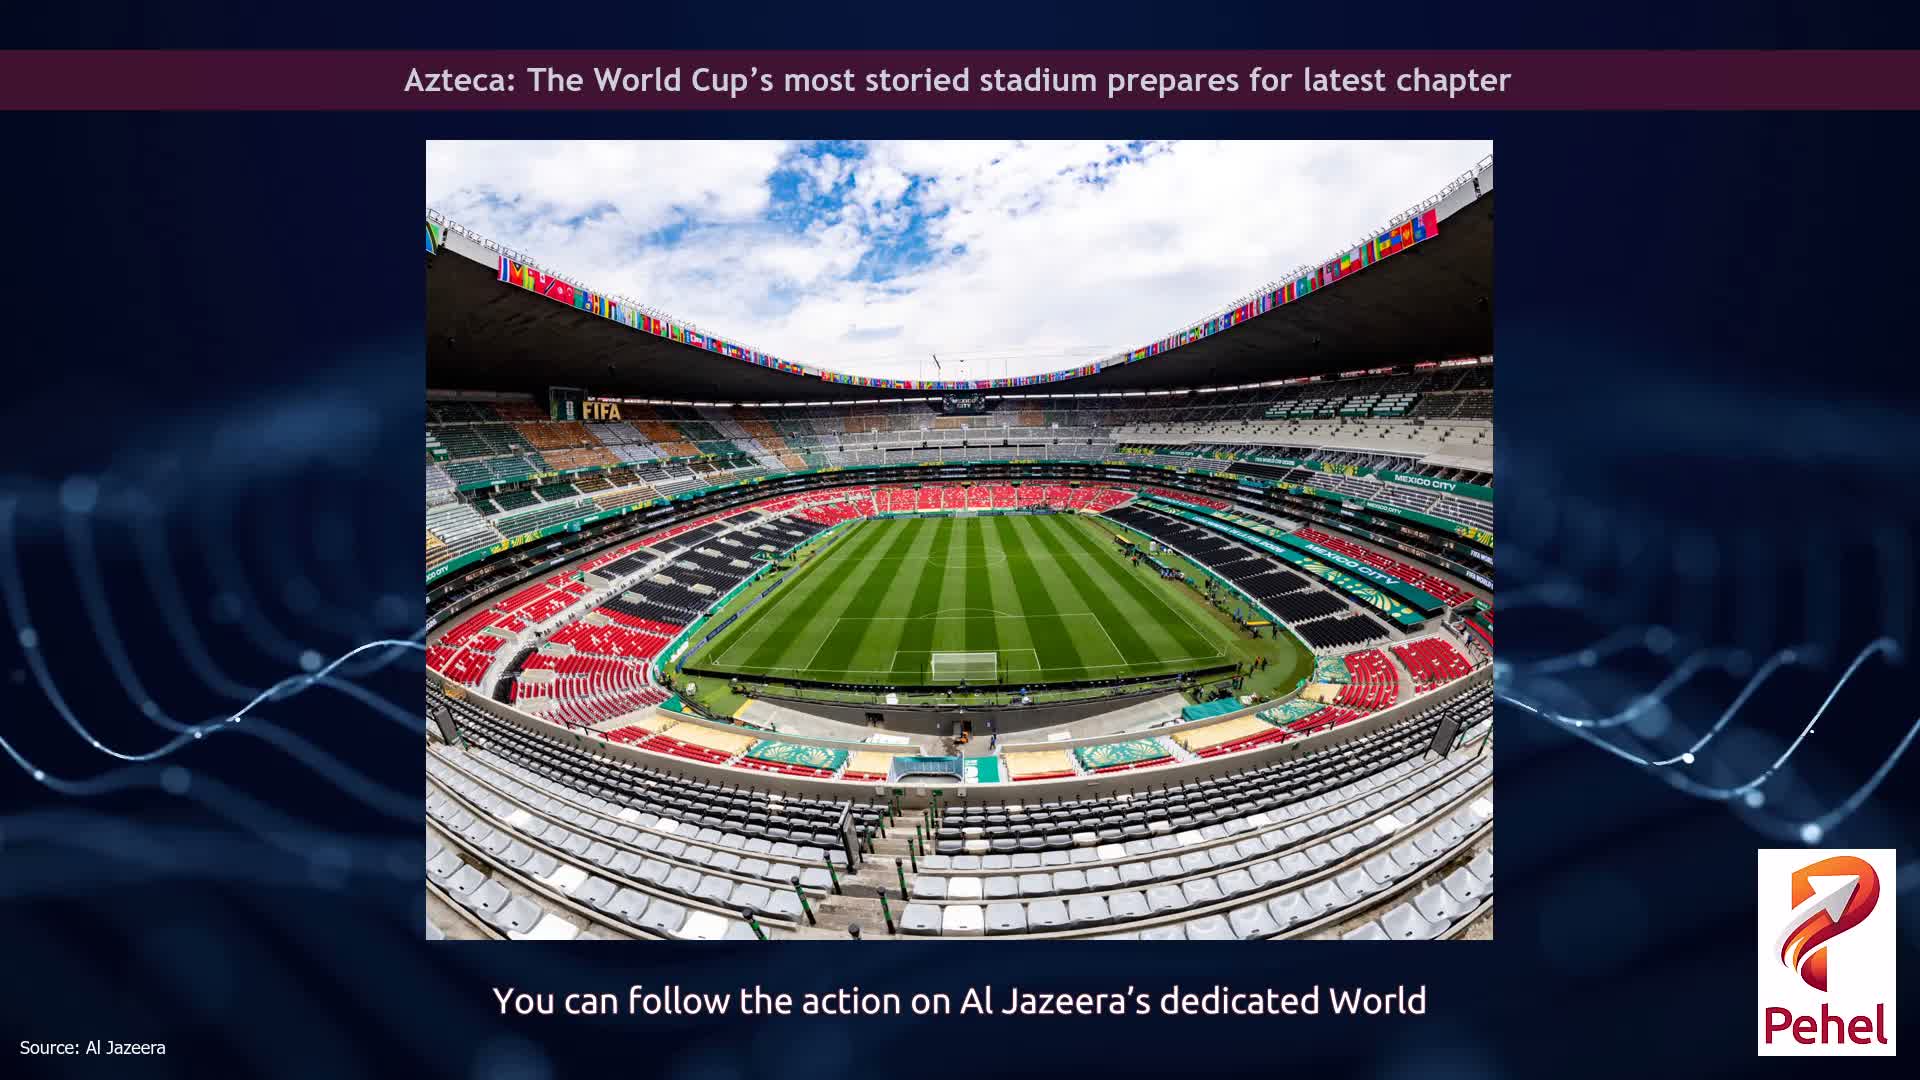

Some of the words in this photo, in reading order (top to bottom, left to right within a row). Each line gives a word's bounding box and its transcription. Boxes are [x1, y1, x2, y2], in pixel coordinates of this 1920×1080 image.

[582, 400, 621, 420] FIFA
[1394, 474, 1431, 488] MEXICO
[1431, 480, 1457, 492] CITY
[1366, 501, 1389, 512] MEXICO
[1387, 507, 1402, 515] CITY
[436, 565, 449, 576] CITY
[1304, 543, 1360, 568] MEXICO
[1357, 565, 1401, 586] CITY
[1465, 570, 1477, 580] FIFA
